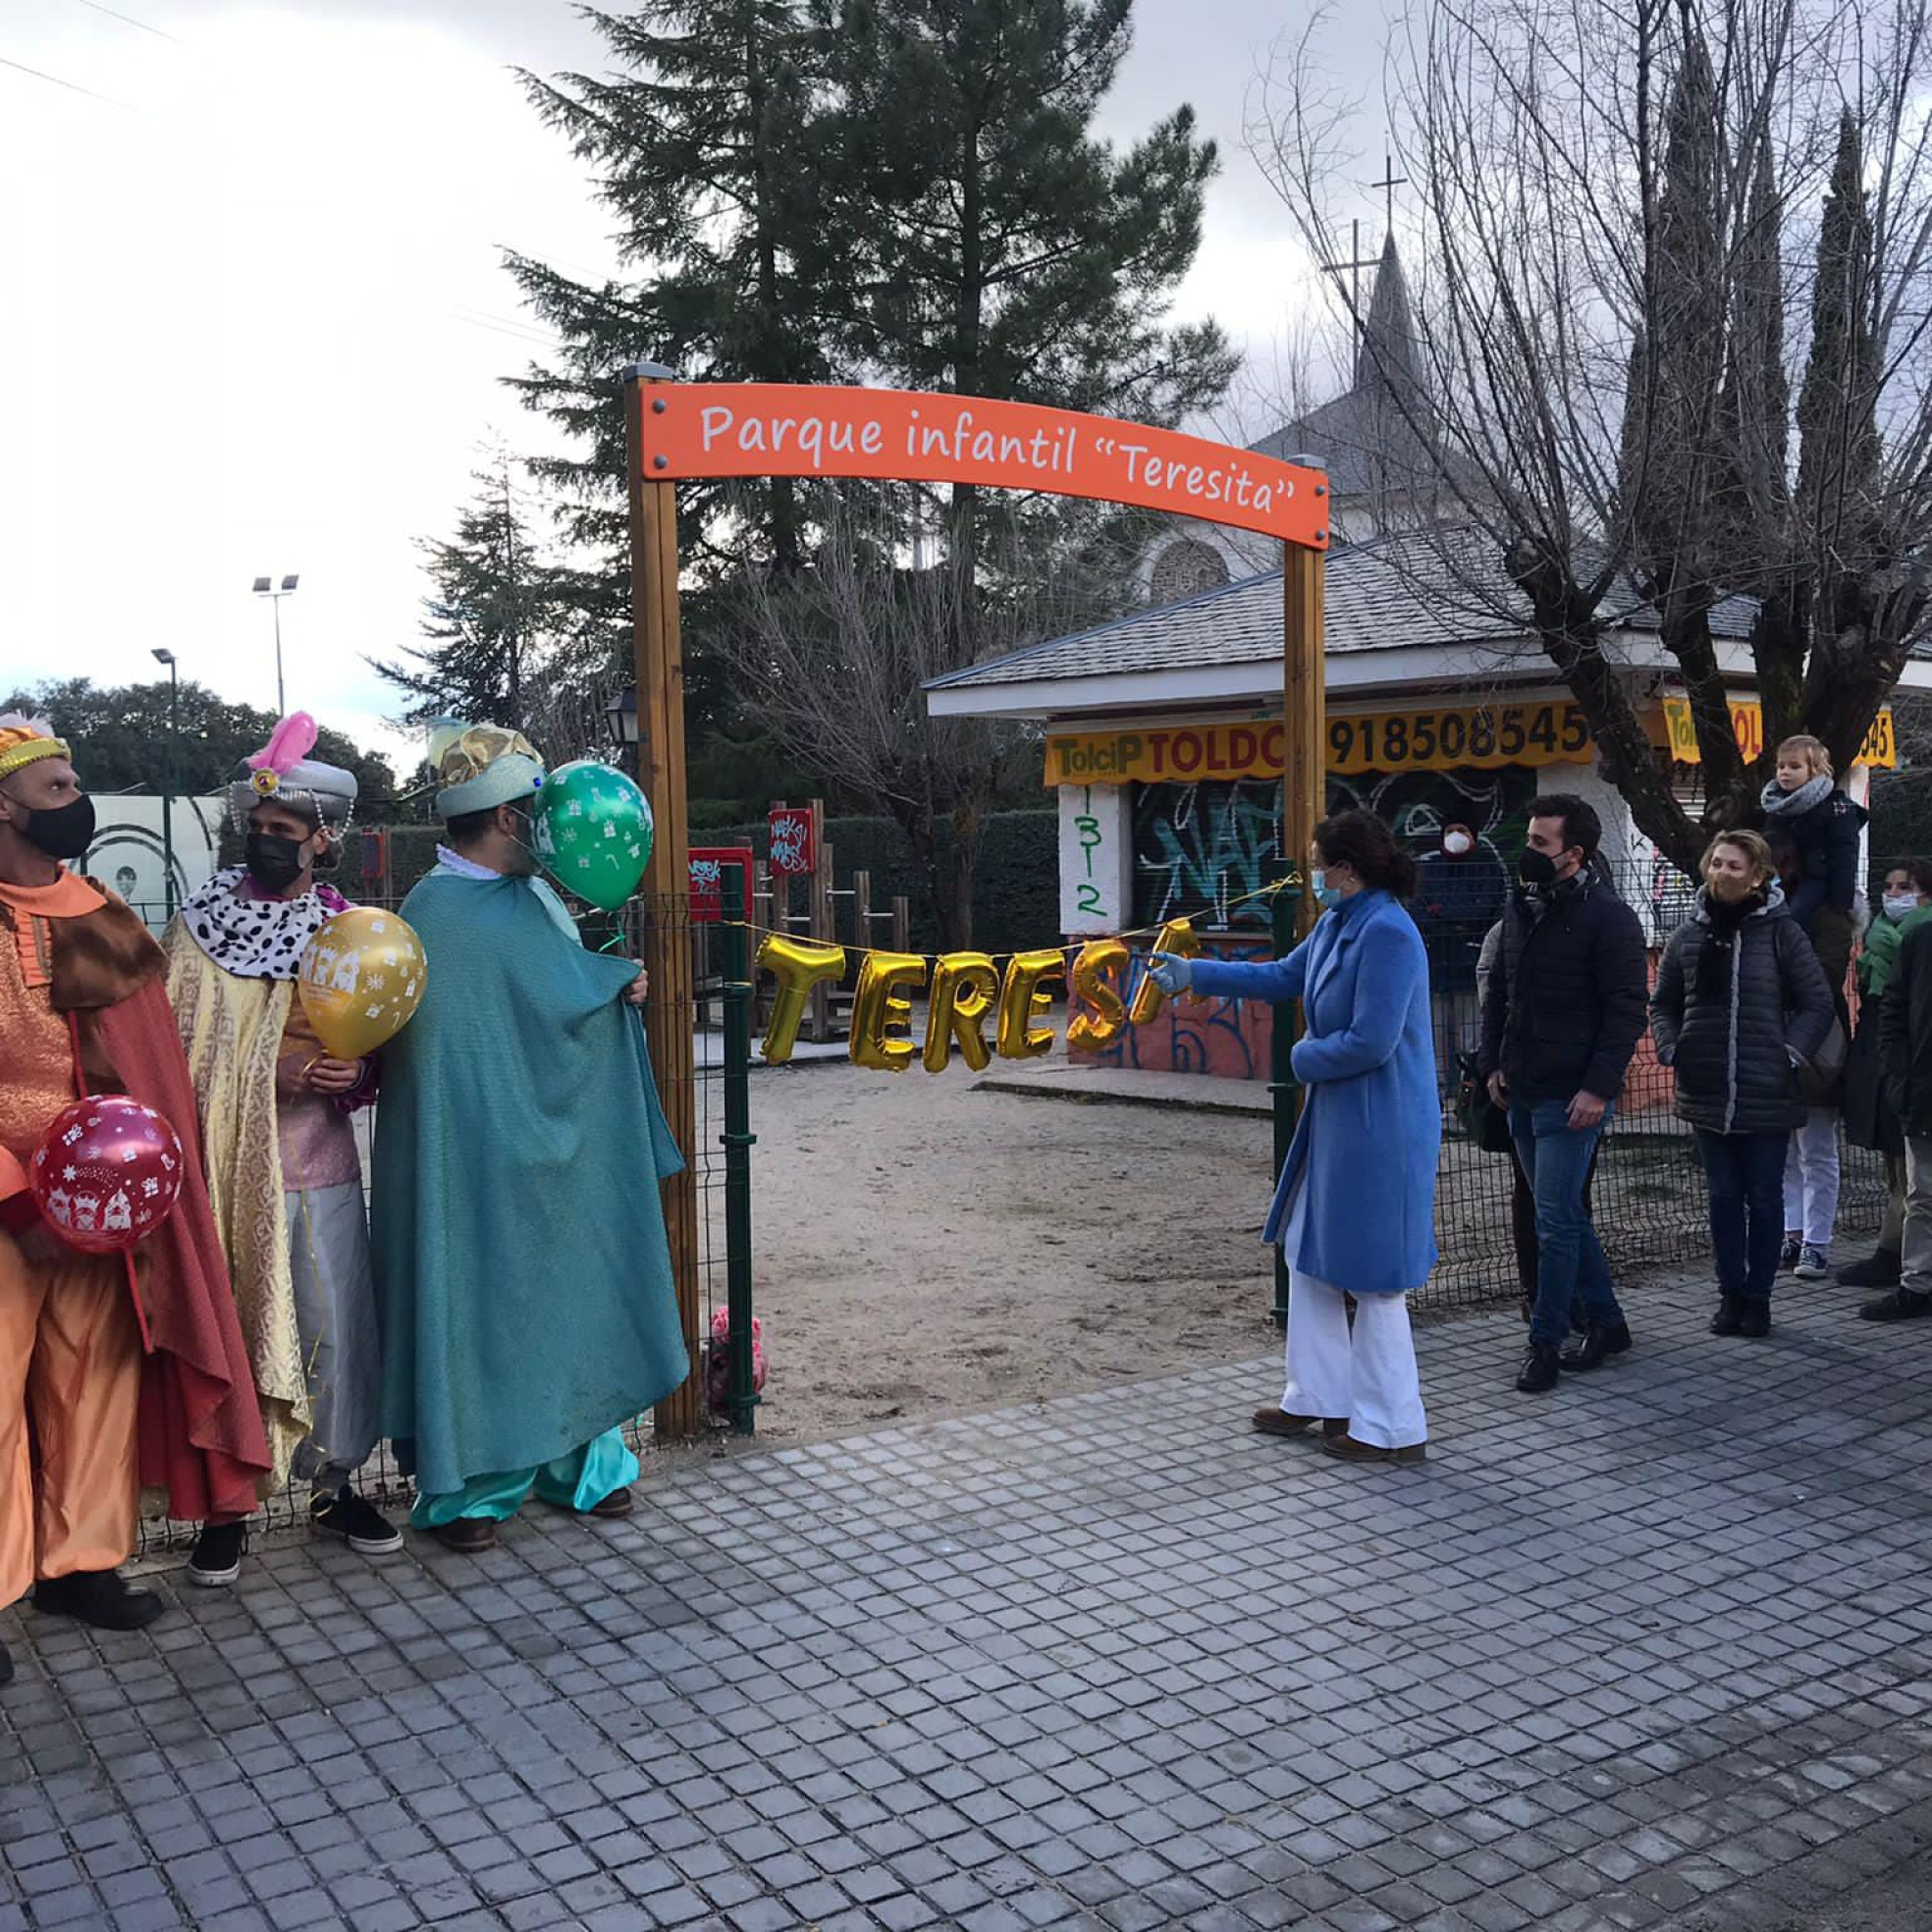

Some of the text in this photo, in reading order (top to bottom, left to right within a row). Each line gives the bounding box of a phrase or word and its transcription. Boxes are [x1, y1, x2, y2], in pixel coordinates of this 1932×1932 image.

[701, 405, 884, 468] Parque
[907, 410, 1077, 472] infantil
[1148, 724, 1285, 774] TOLDO
[1328, 705, 1589, 765] 918508545
